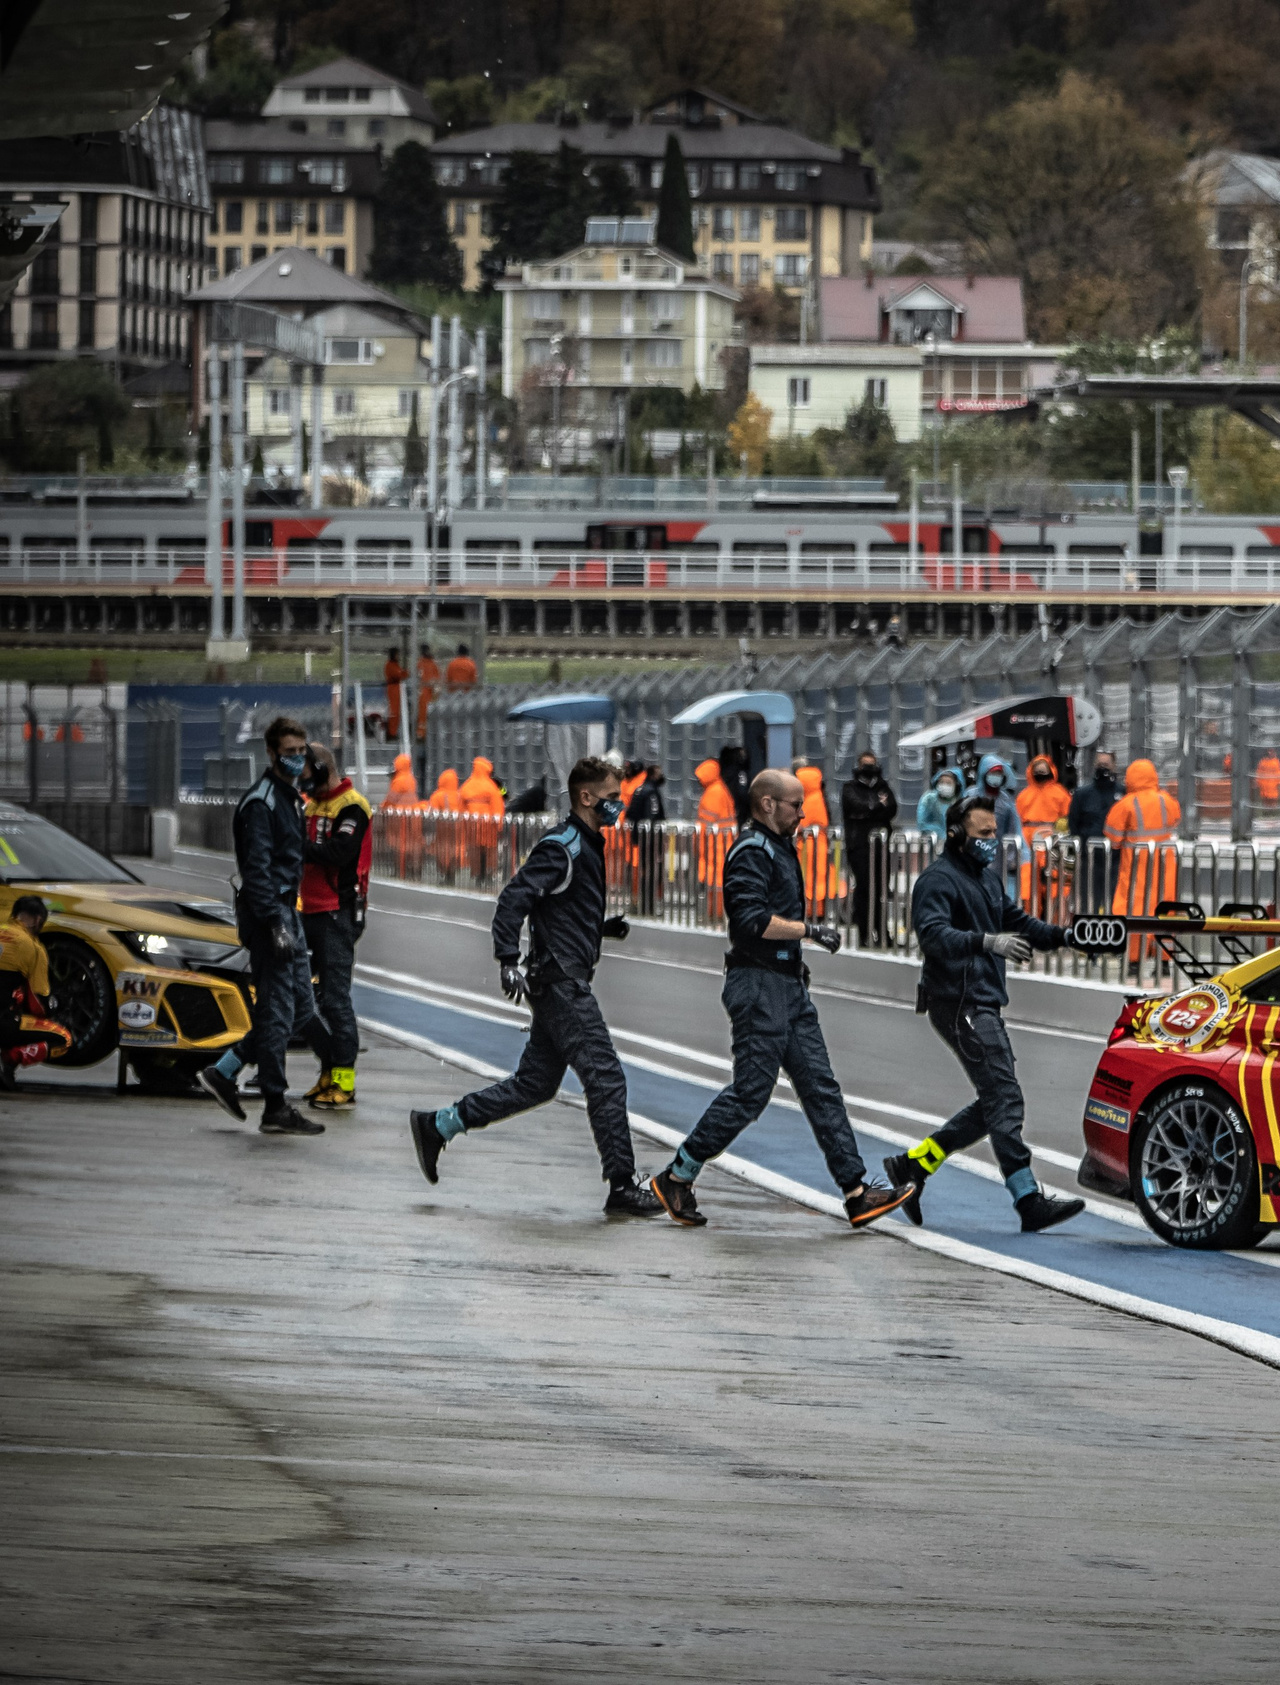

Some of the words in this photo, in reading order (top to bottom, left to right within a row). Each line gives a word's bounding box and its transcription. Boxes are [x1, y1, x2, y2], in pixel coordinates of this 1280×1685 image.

[122, 980, 161, 997] KW
[1166, 1009, 1201, 1030] 125
[1088, 1105, 1127, 1125] GOODYEAR
[1146, 1088, 1183, 1124] EAGLE
